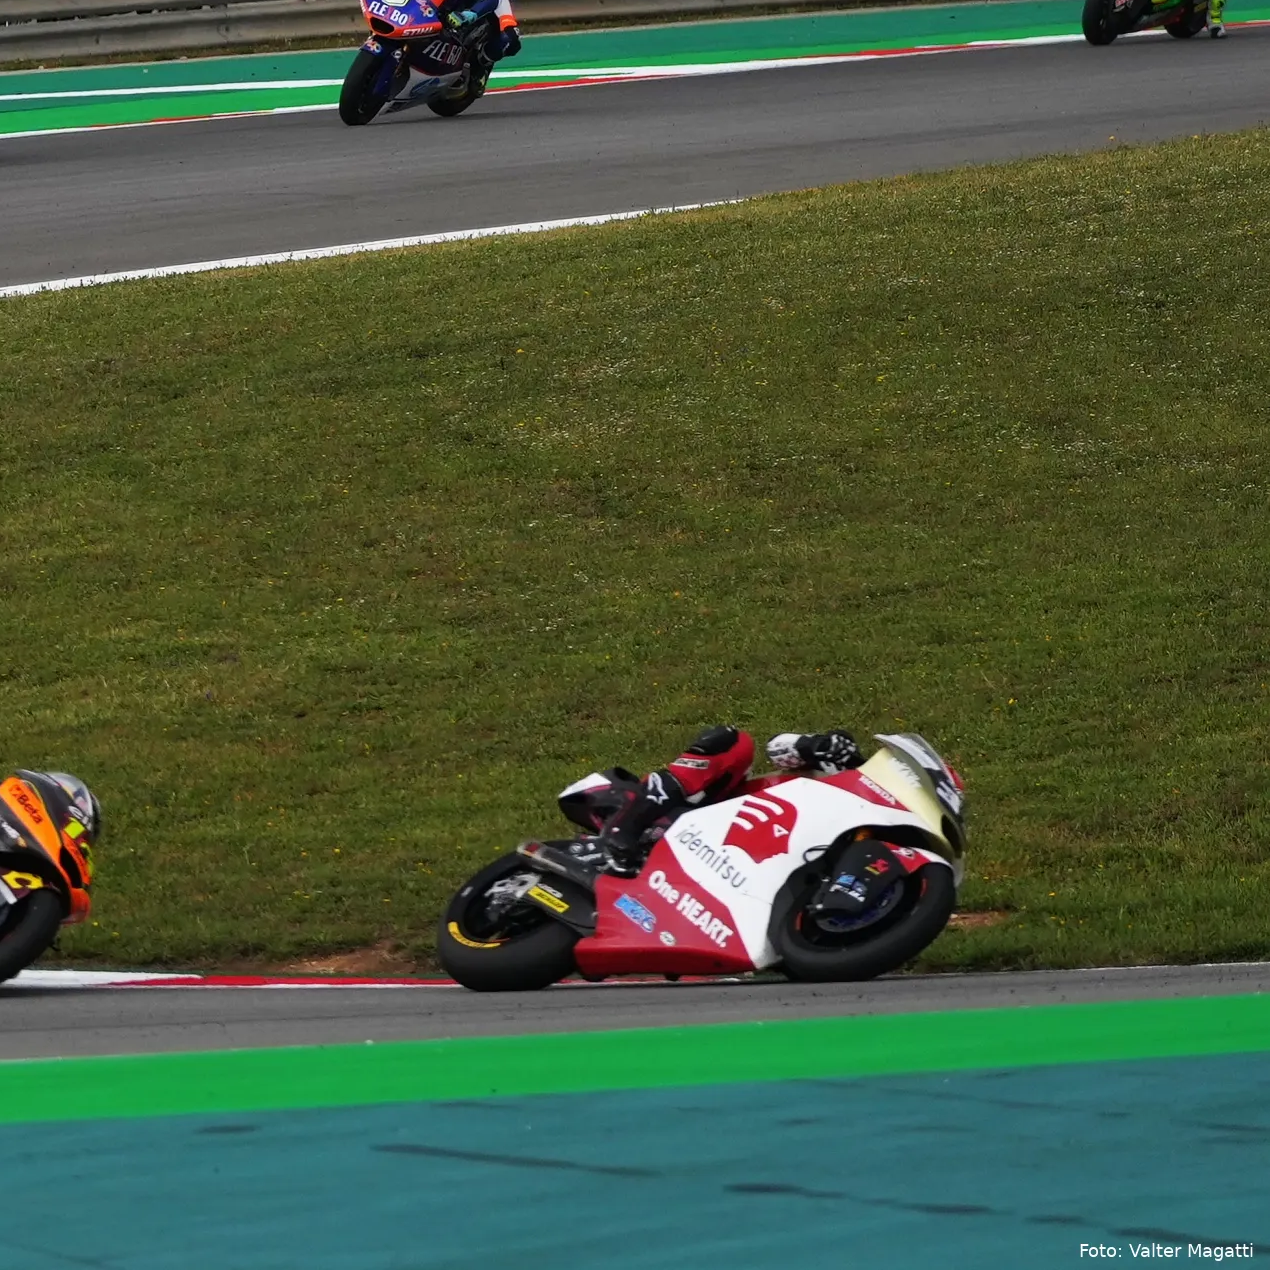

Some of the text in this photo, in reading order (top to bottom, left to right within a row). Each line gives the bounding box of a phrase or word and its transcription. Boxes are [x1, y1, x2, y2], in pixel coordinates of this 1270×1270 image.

[860, 775, 896, 804] HONDA
[17, 794, 44, 825] Beta
[675, 823, 747, 889] idemitsu
[648, 870, 676, 904] One
